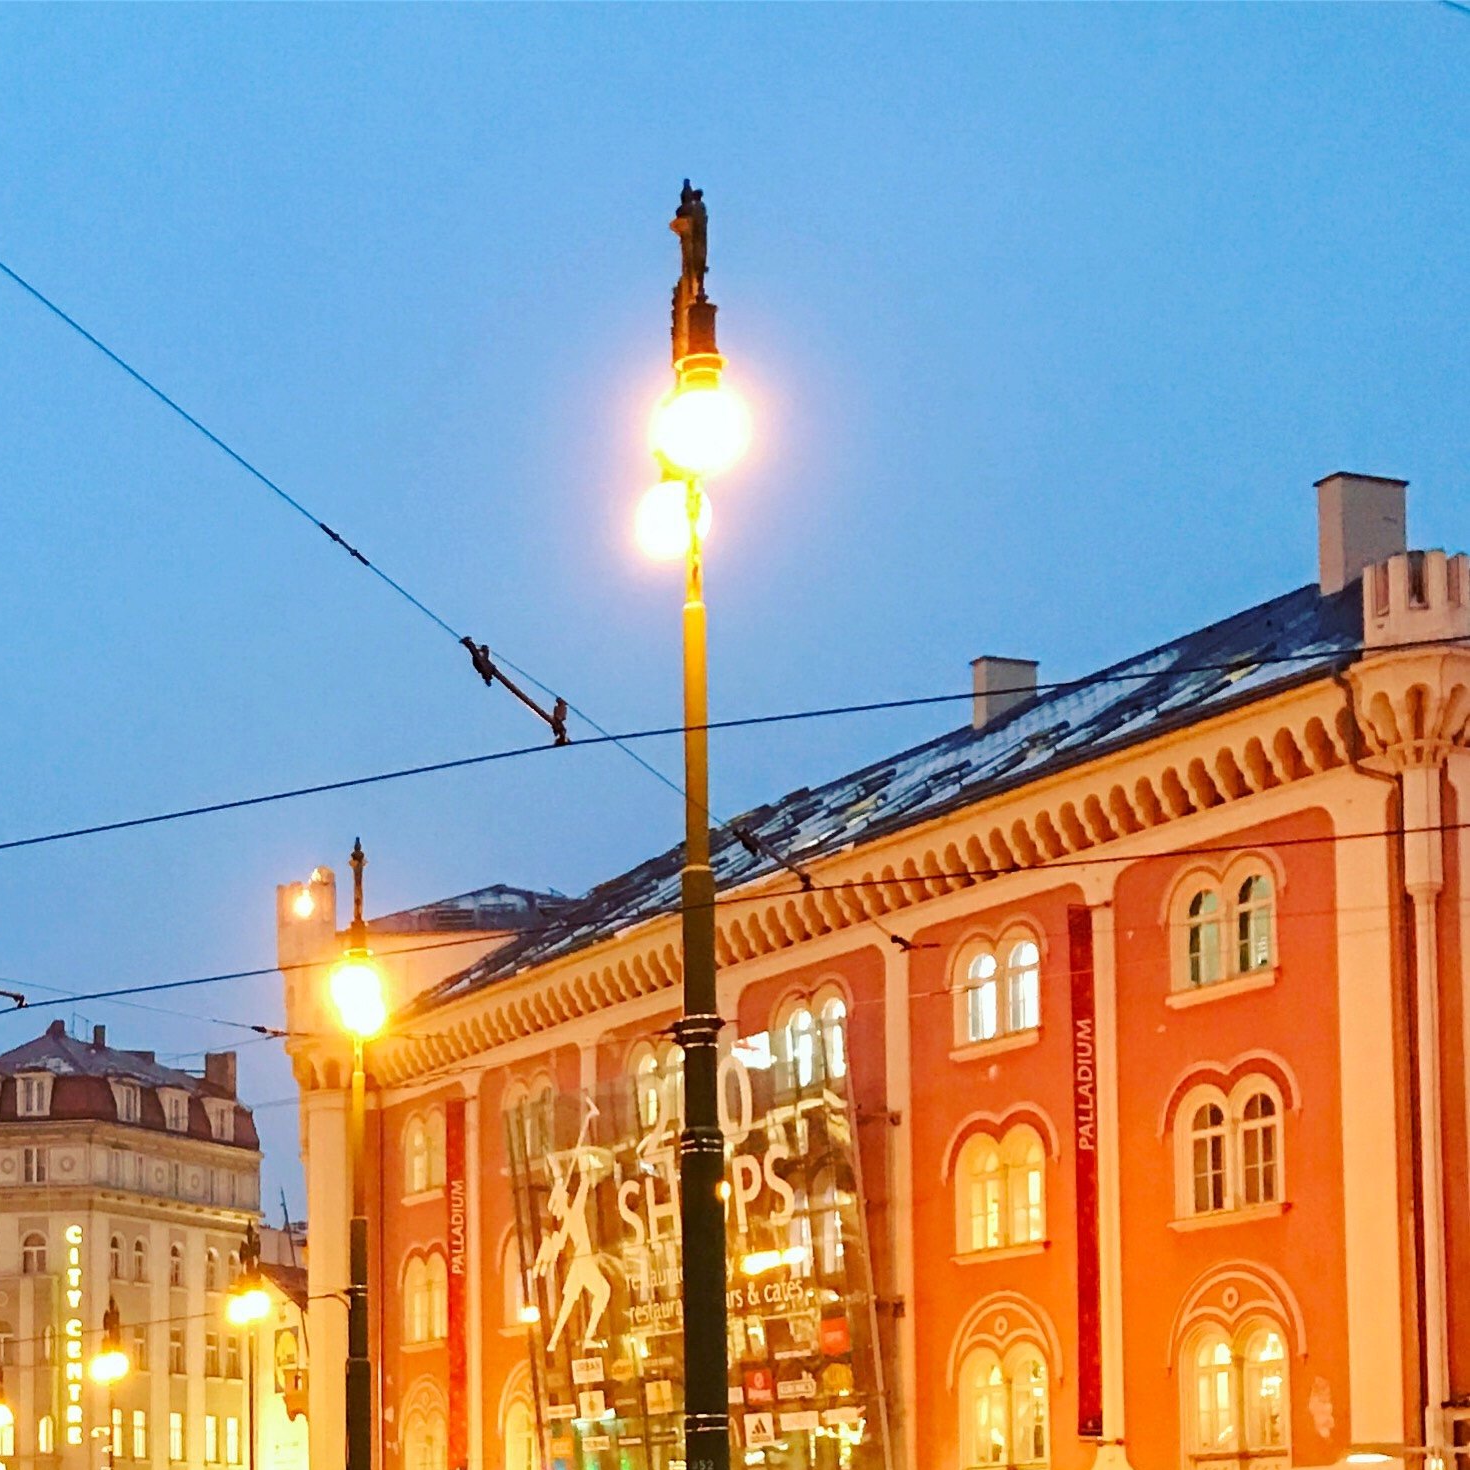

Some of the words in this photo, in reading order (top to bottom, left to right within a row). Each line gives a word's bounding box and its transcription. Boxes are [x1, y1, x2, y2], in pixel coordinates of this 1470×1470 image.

[1076, 1018, 1095, 1151] PALLADIUM
[451, 1180, 465, 1275] PALLADIUM
[618, 1143, 795, 1247] SHPS
[65, 1225, 83, 1308] CITY
[65, 1318, 83, 1445] CENTRE
